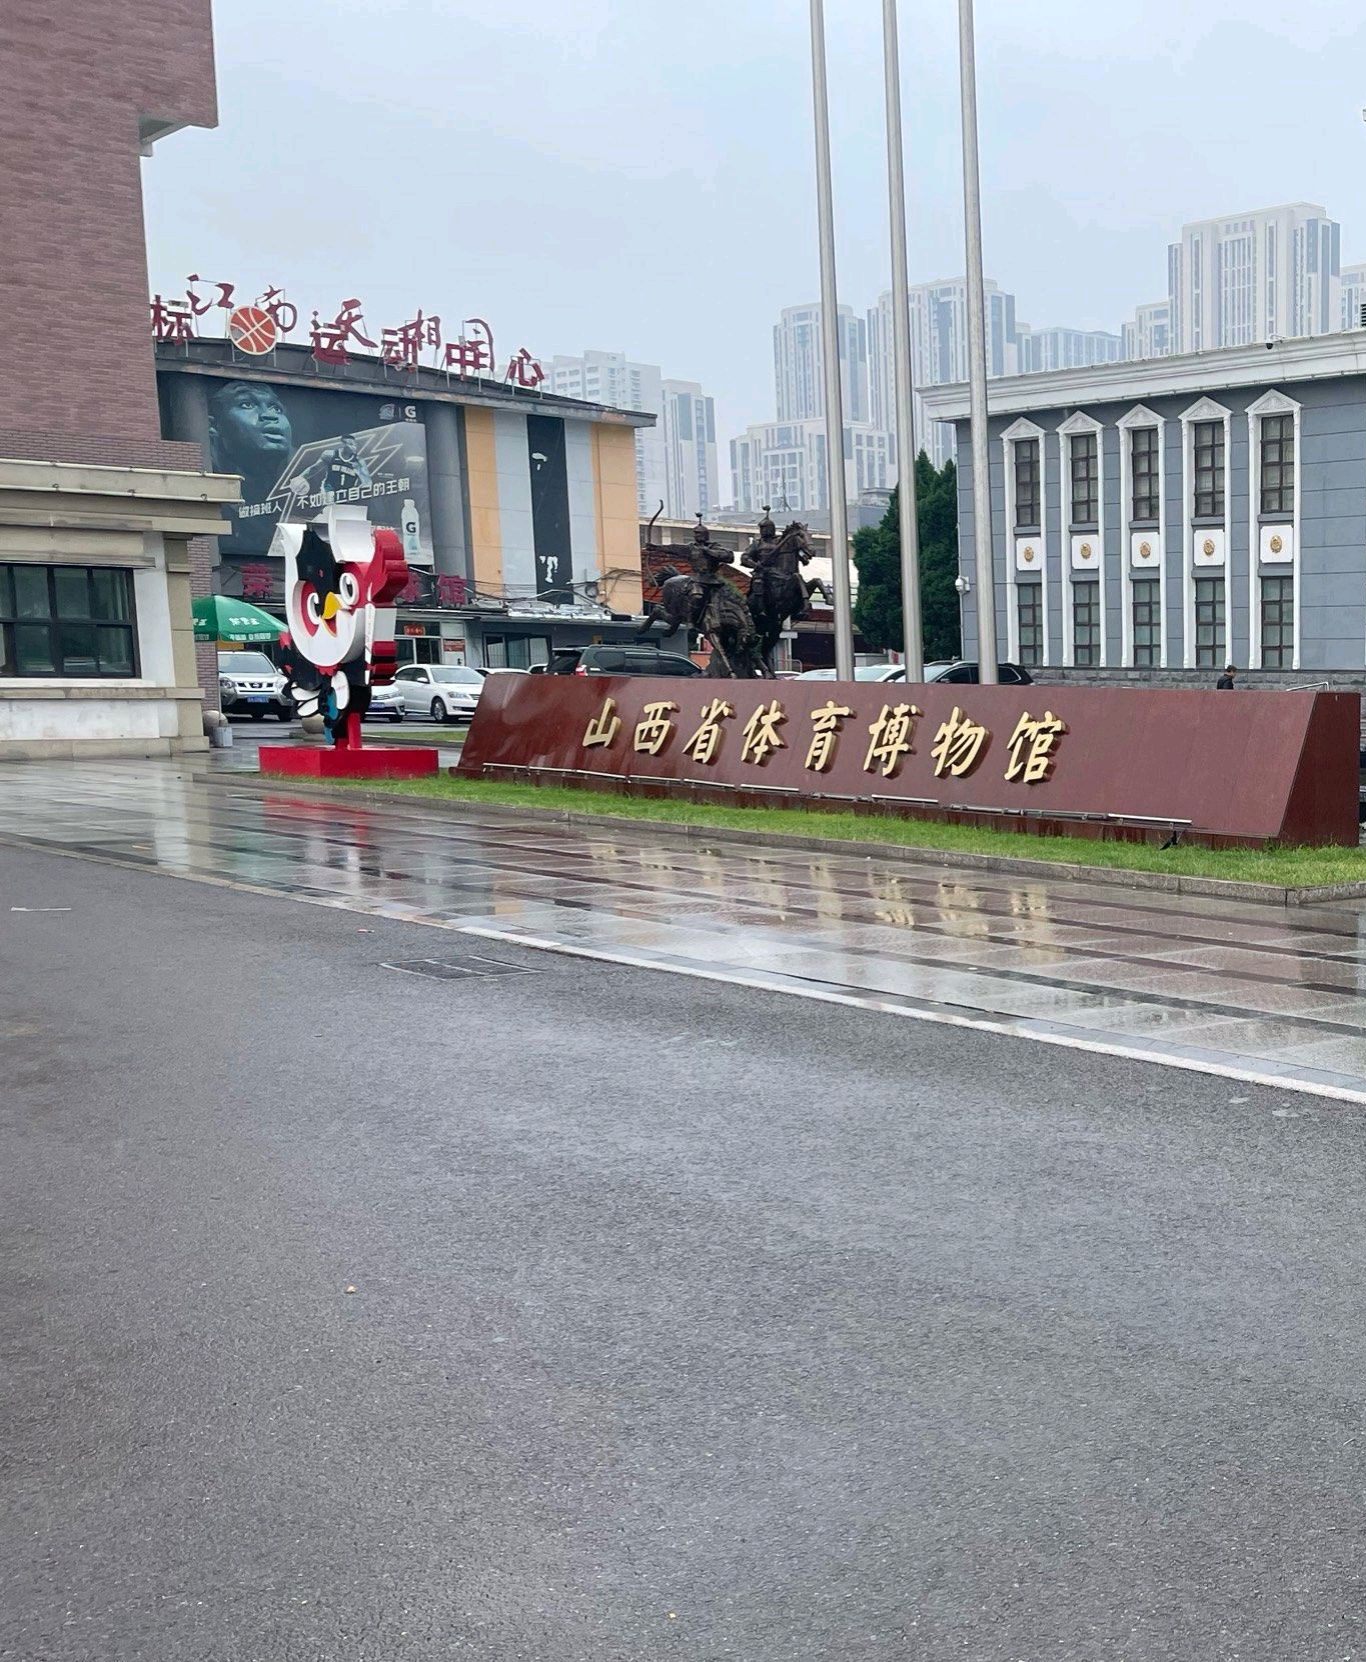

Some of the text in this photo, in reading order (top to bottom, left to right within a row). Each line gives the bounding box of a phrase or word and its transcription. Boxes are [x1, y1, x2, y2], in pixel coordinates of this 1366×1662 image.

[406, 522, 417, 533] G
[582, 697, 1065, 784] 山西省体育博物馆
